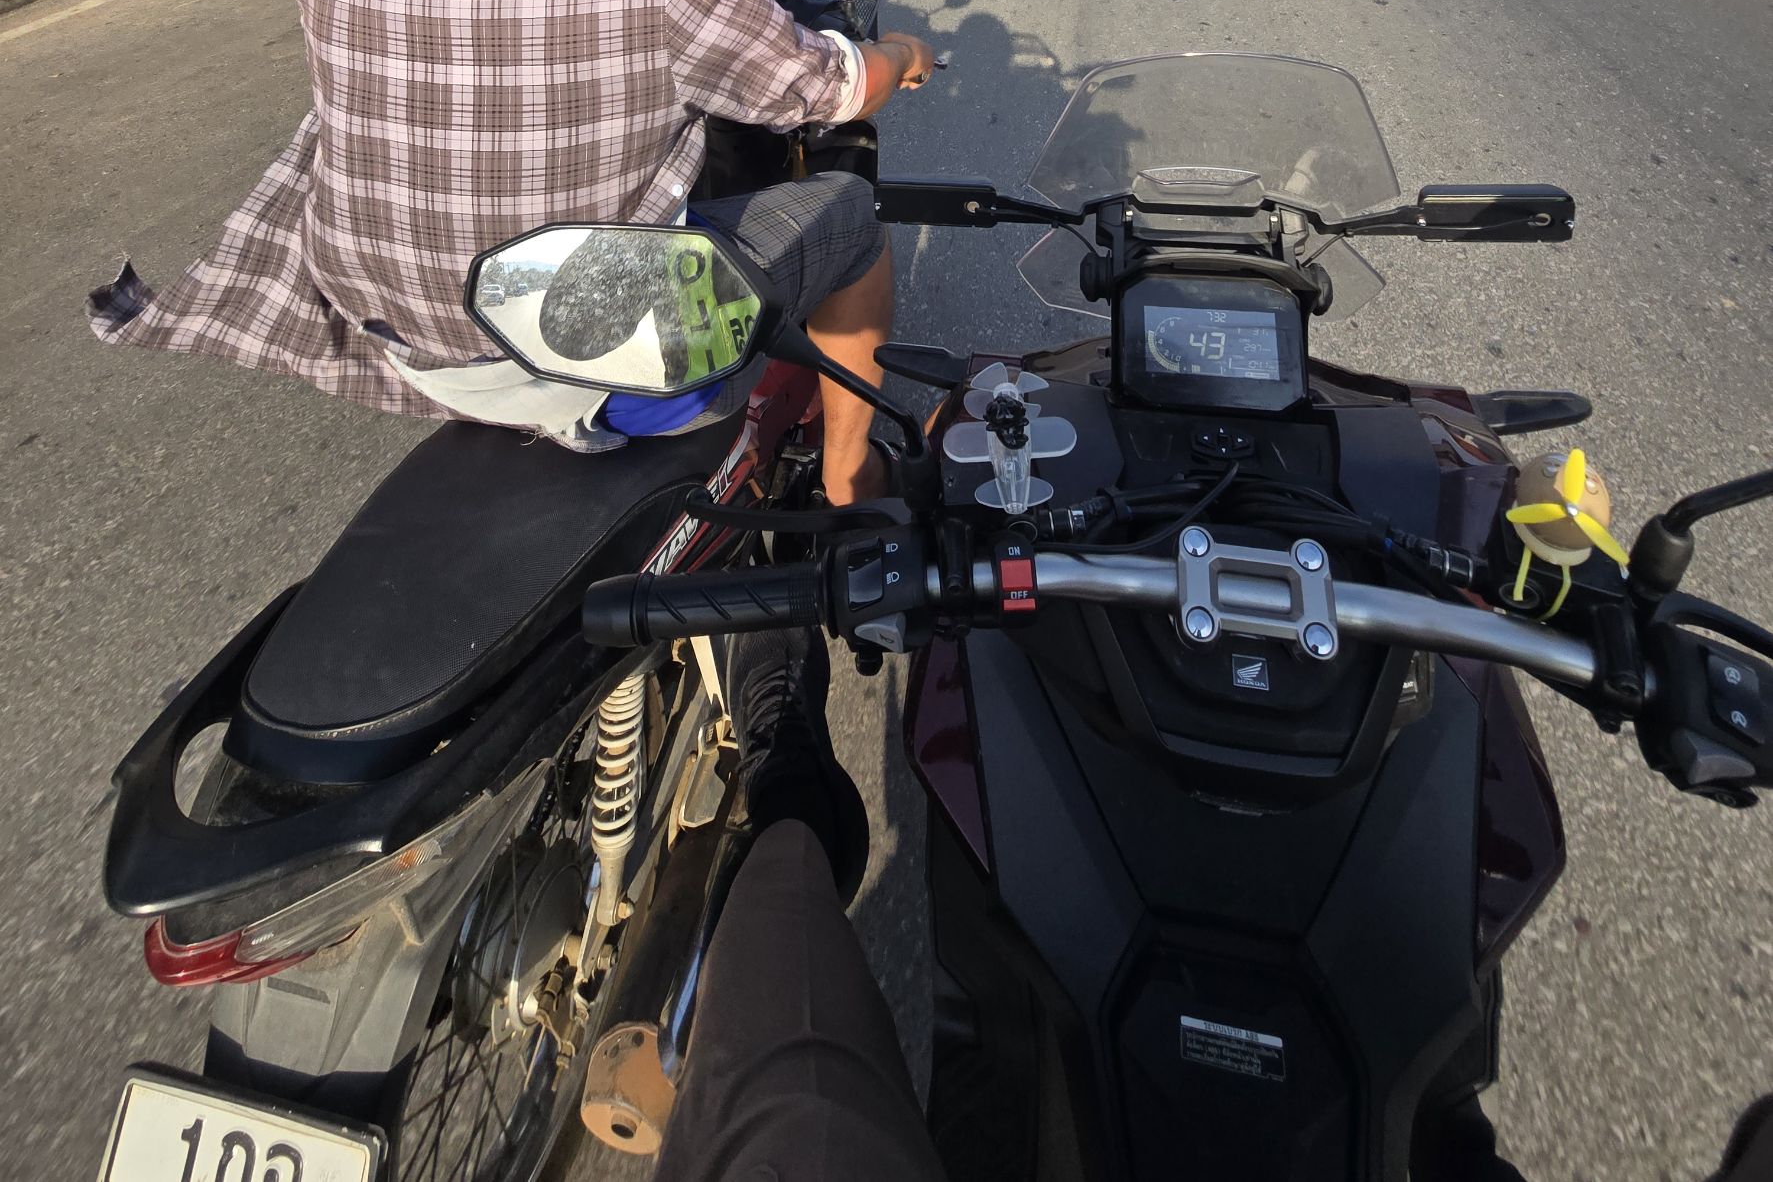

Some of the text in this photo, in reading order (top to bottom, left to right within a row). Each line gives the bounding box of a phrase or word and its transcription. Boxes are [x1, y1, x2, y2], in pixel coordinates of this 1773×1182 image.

[1189, 331, 1226, 360] 43
[1008, 546, 1021, 556] ON
[1010, 590, 1029, 600] OFF
[1237, 678, 1266, 687] HONDA
